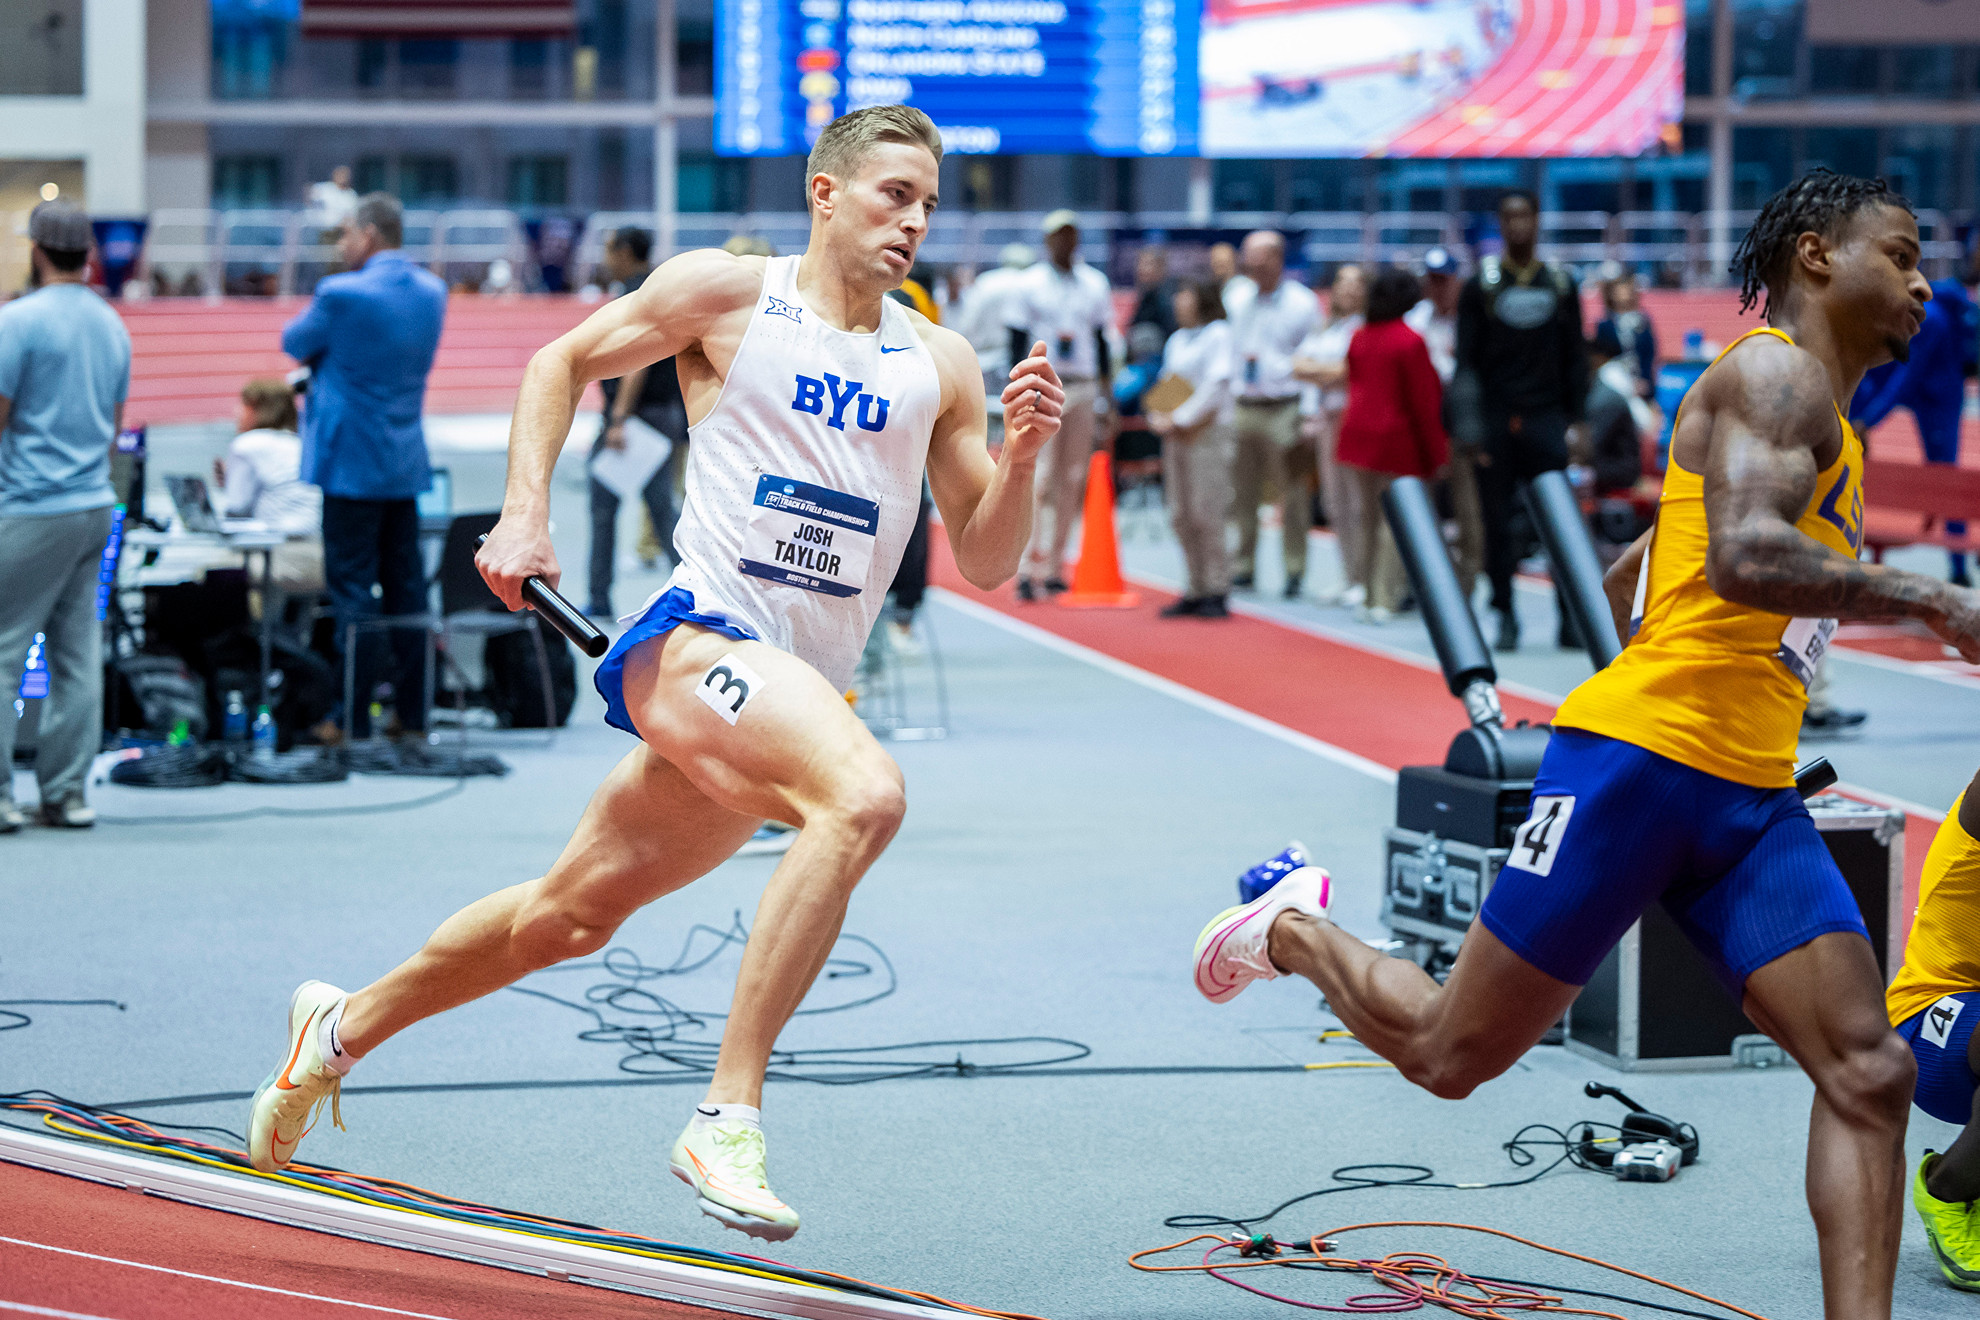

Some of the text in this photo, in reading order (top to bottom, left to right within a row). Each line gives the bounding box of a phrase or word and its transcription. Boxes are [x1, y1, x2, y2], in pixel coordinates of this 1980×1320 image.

[791, 372, 890, 433] BYU
[780, 497, 800, 509] TRACK
[805, 504, 823, 515] FIELD
[822, 508, 870, 528] CHAMPIONSHIPS
[1818, 463, 1863, 560] LS
[793, 523, 834, 547] JOSH
[774, 539, 841, 577] TAYLOR
[704, 665, 749, 713] 3
[1522, 801, 1562, 867] 4
[1930, 1006, 1956, 1038] 4
